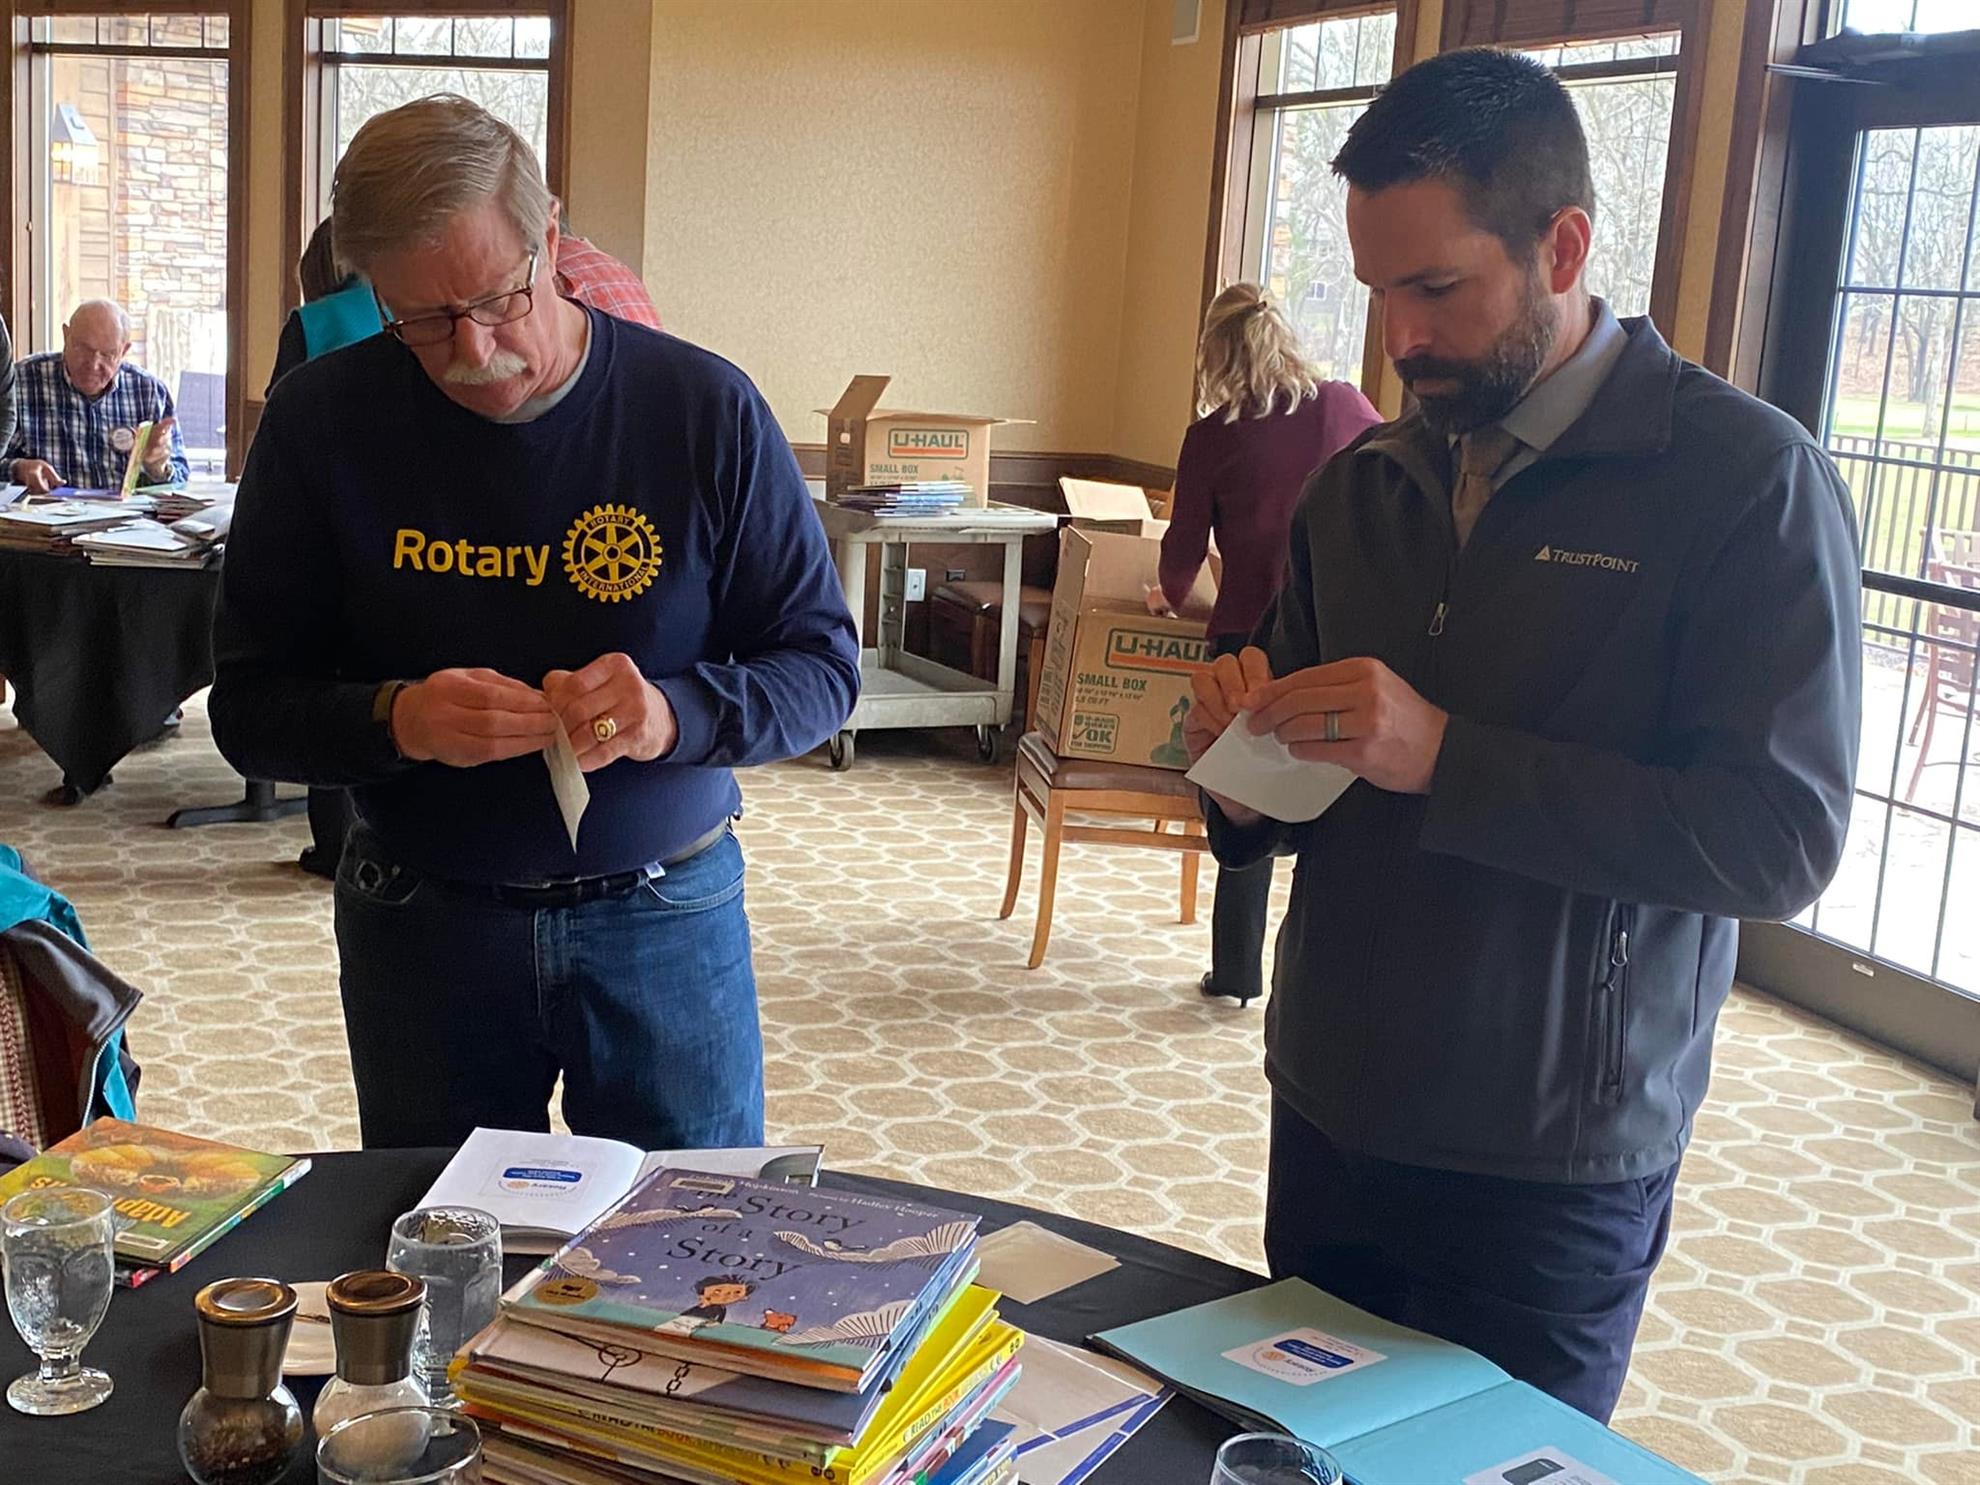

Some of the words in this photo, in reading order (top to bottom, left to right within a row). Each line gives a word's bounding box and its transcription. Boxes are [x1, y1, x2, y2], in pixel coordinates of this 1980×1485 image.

[894, 433, 964, 448] U-HAUL
[869, 464, 899, 474] SMALL
[902, 464, 919, 474] BOX
[590, 515, 630, 528] ROTARY
[393, 529, 550, 586] Rotary
[1552, 549, 1641, 574] TRUSTPOINT
[579, 564, 650, 592] INTERNATIONAL
[1077, 672, 1119, 688] SMALL
[1122, 677, 1148, 692] BOX
[1085, 728, 1112, 743] OK
[734, 1195, 867, 1234] Story
[701, 1222, 741, 1234] of
[665, 1239, 802, 1281] Story
[910, 1411, 931, 1436] READ
